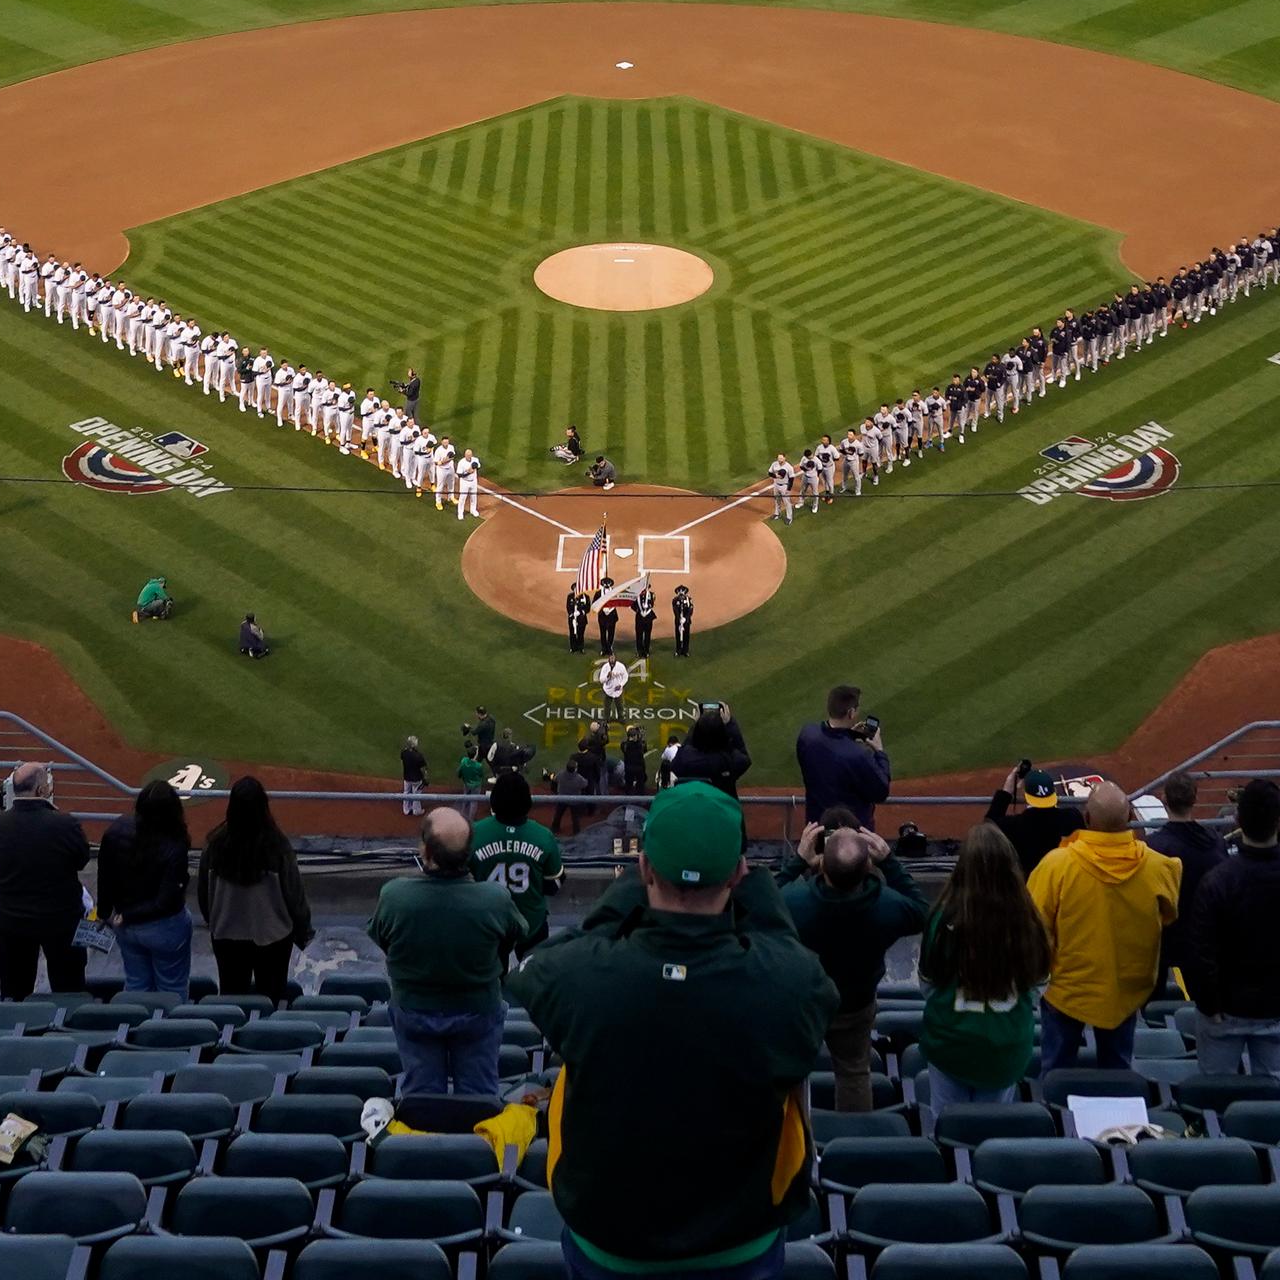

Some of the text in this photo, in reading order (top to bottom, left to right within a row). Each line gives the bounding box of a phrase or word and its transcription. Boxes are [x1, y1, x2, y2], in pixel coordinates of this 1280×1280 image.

[69, 416, 234, 498] OPENING DAY
[1015, 420, 1175, 505] OPENING DAY
[167, 764, 216, 800] A's
[475, 840, 544, 862] MIDDLEBROOK
[486, 862, 530, 894] 49
